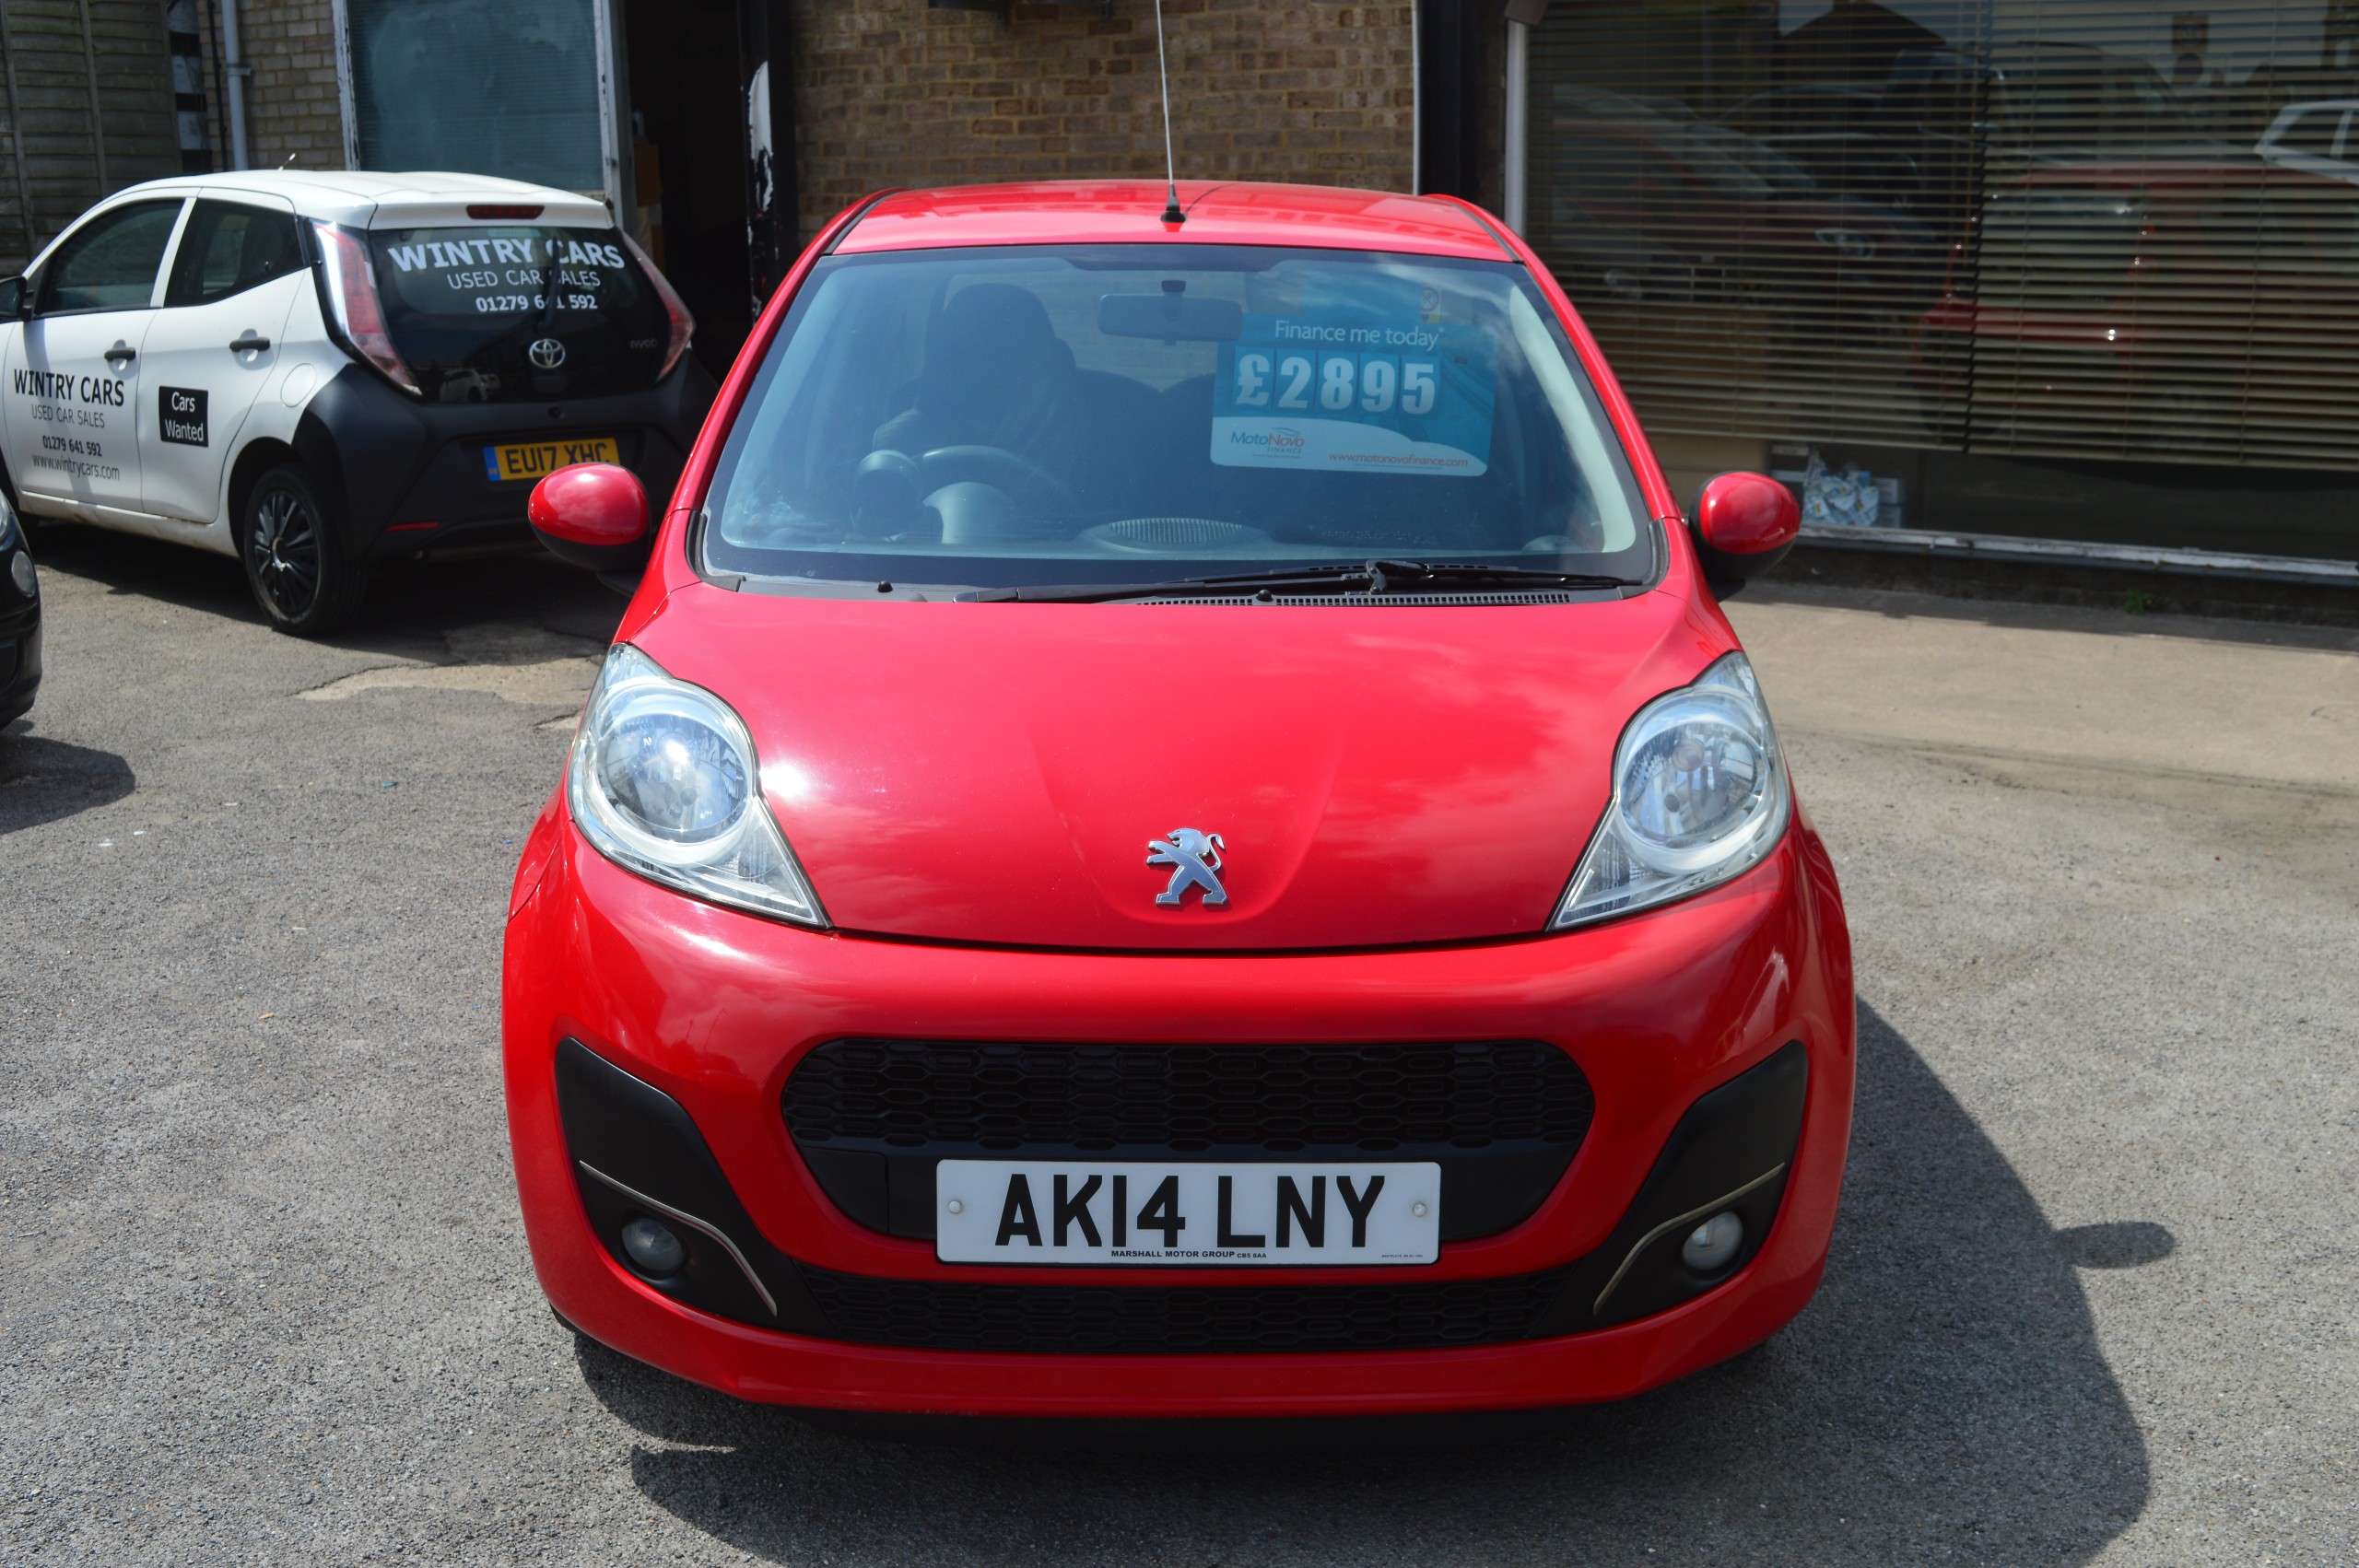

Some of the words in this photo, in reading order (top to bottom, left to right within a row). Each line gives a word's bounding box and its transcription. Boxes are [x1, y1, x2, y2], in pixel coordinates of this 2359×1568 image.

[388, 239, 534, 272] WINTRY
[447, 271, 499, 289] USED
[505, 269, 546, 287] CAR
[550, 270, 602, 287] ALES
[475, 295, 529, 312] 01279
[534, 294, 565, 310] 61
[569, 294, 598, 310] 592
[1274, 320, 1346, 342] Finance
[1350, 326, 1380, 343] me
[14, 369, 75, 401] WINTRY
[80, 375, 125, 406] CARS
[1235, 353, 1436, 415] £2895
[171, 391, 195, 413] Cars
[30, 403, 53, 421] USED
[56, 405, 75, 424] CAR
[76, 409, 105, 428] SALES
[164, 418, 204, 442] Wanted
[1230, 430, 1306, 448] MotoNovo
[42, 435, 66, 451] 01279
[68, 438, 85, 454] 641
[87, 441, 102, 457] 592
[31, 453, 121, 481] www.wintrycars.com
[505, 445, 557, 474] EU17
[994, 1173, 1187, 1248] AK14
[1216, 1175, 1386, 1249] LNY
[1202, 1250, 1236, 1258] GROUP
